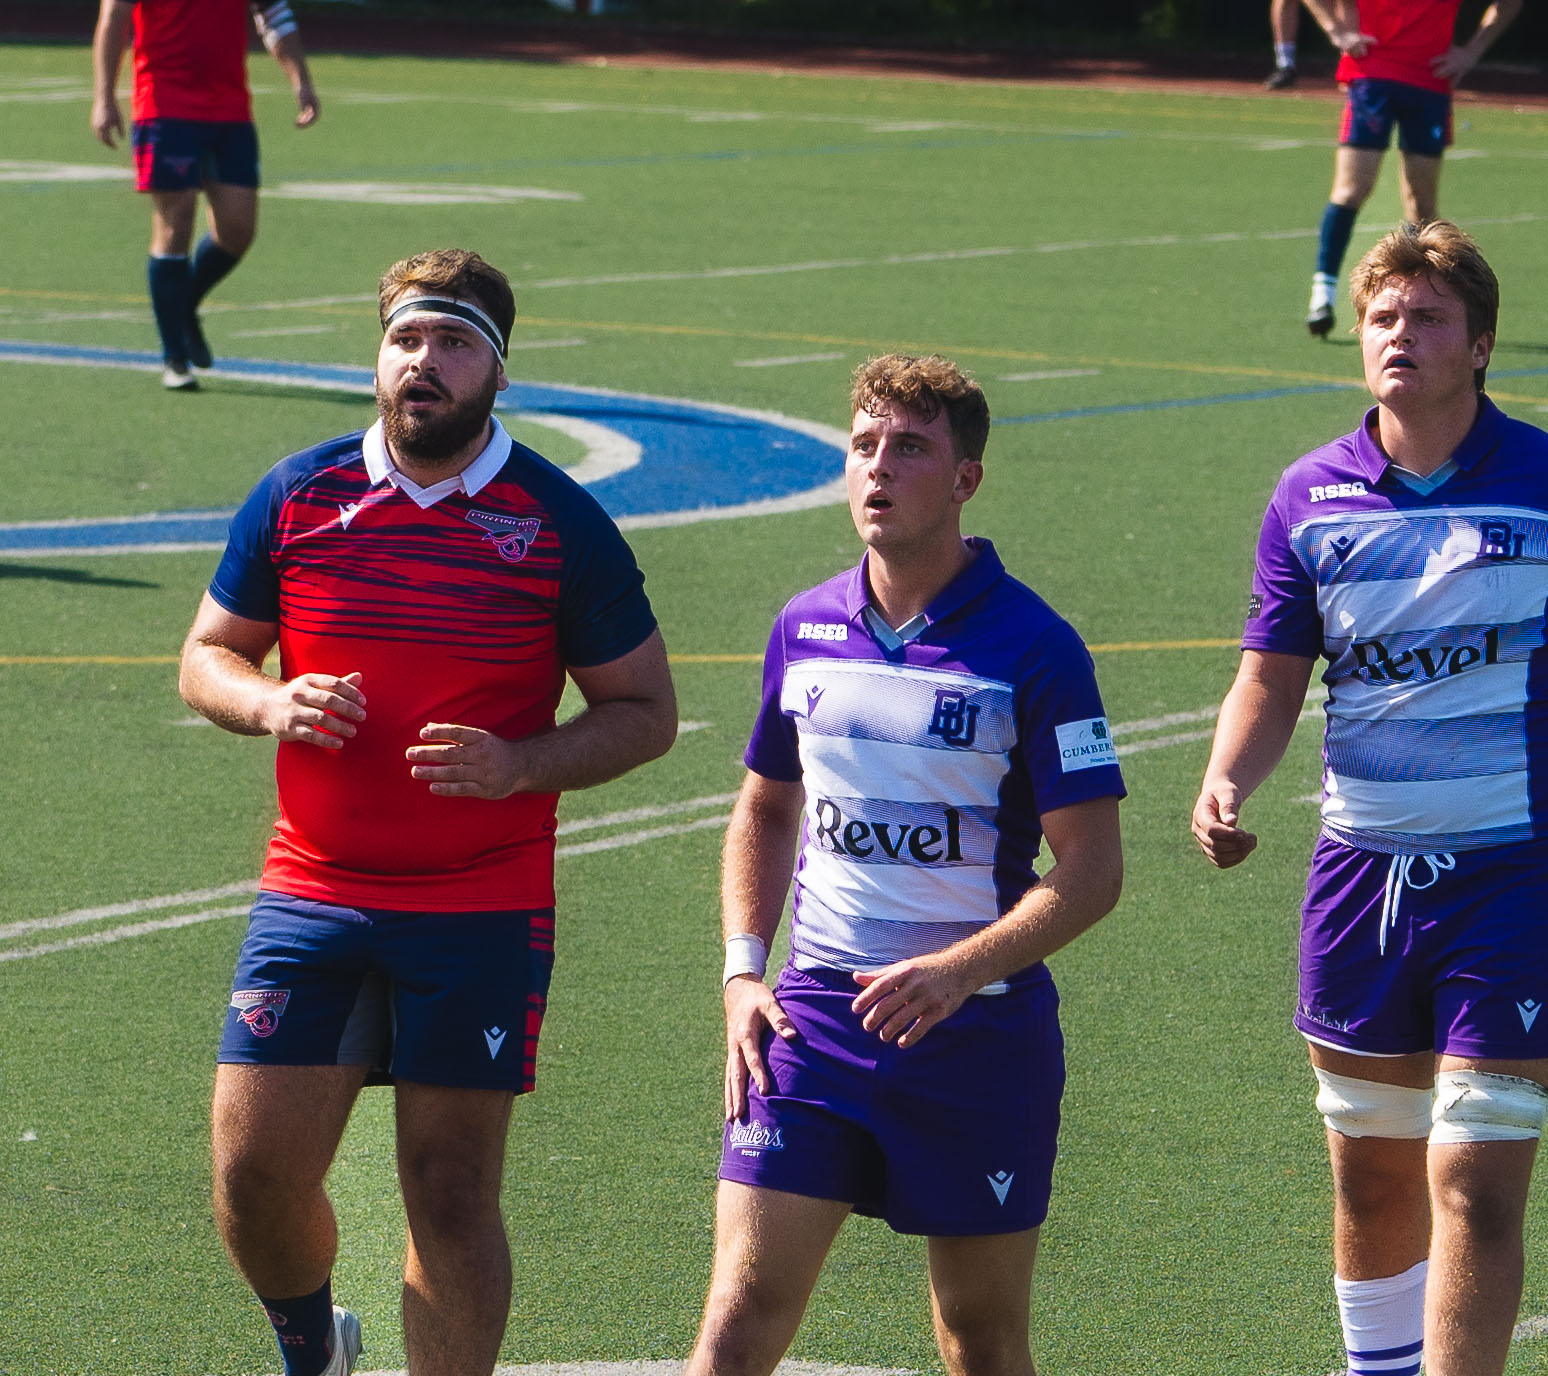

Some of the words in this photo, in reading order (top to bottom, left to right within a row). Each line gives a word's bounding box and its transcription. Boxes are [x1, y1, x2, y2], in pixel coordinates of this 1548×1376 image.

[1309, 481, 1368, 503] RSEQ
[797, 622, 848, 642] RSEQ
[1350, 627, 1499, 682] Revel
[928, 688, 980, 747] BU
[815, 797, 964, 864] Revel
